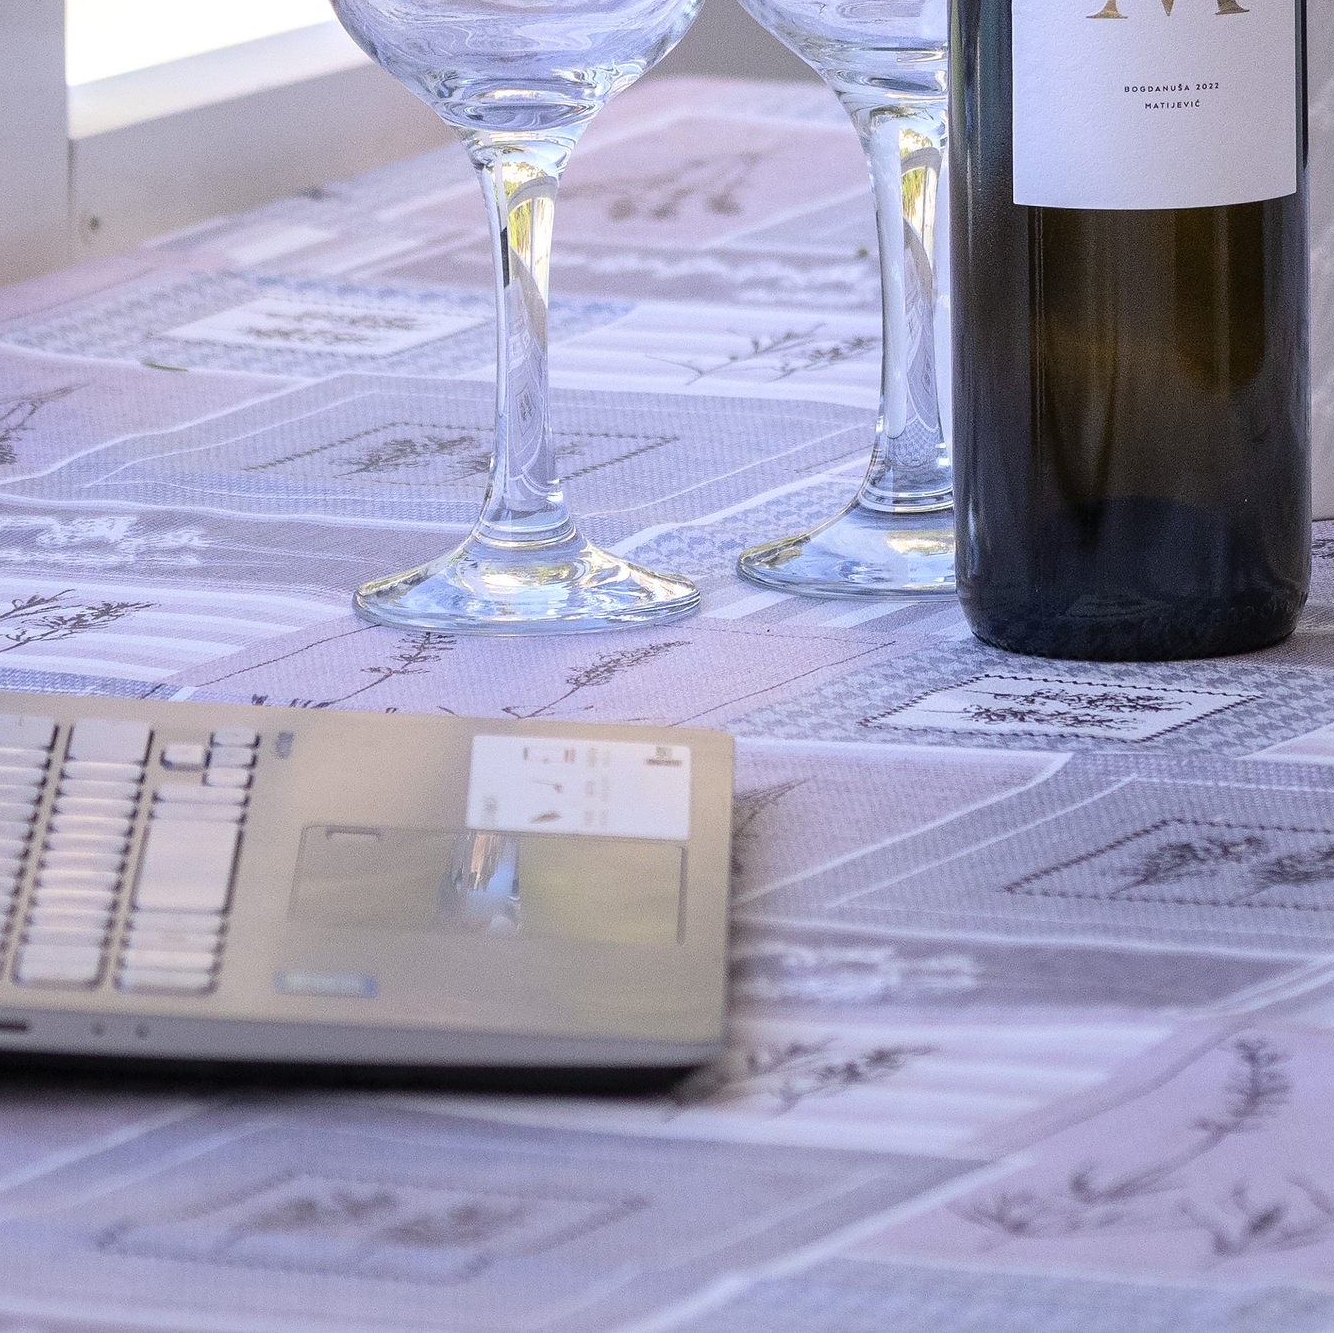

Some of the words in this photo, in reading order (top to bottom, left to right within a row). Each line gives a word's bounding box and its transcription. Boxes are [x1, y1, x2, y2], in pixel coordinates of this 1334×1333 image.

[1124, 83, 1190, 93] BOGDANUŠA
[1195, 82, 1220, 91] 2022
[1144, 99, 1201, 110] MATIJEVIĆ
